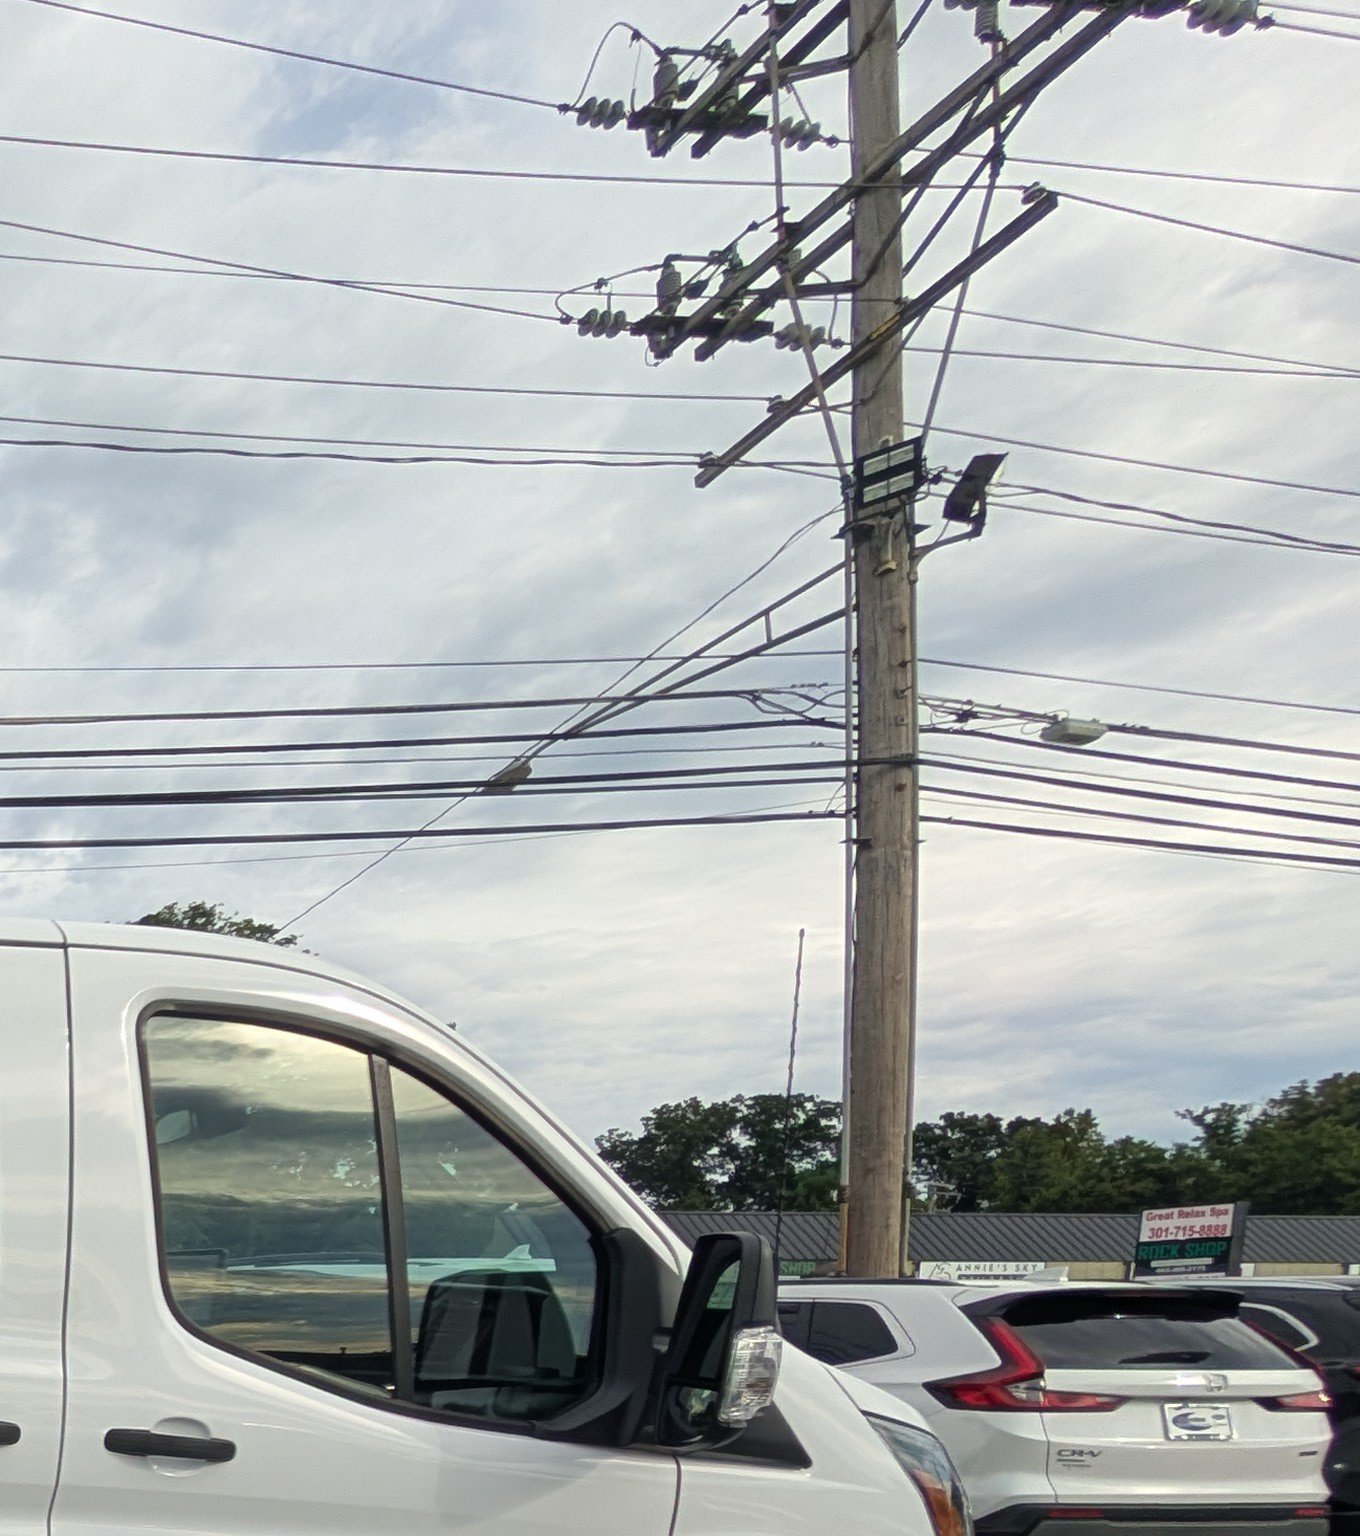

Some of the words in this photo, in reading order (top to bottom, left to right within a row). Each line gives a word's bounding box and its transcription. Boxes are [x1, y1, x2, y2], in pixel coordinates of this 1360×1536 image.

[1146, 1211, 1175, 1222] Great
[1177, 1208, 1206, 1219] Relax
[1209, 1207, 1229, 1219] Spa
[1139, 1244, 1179, 1259] ROCK
[1185, 1242, 1227, 1257] SHOP
[956, 1262, 1008, 1273] ANNIE'S
[1014, 1262, 1039, 1273] SKY
